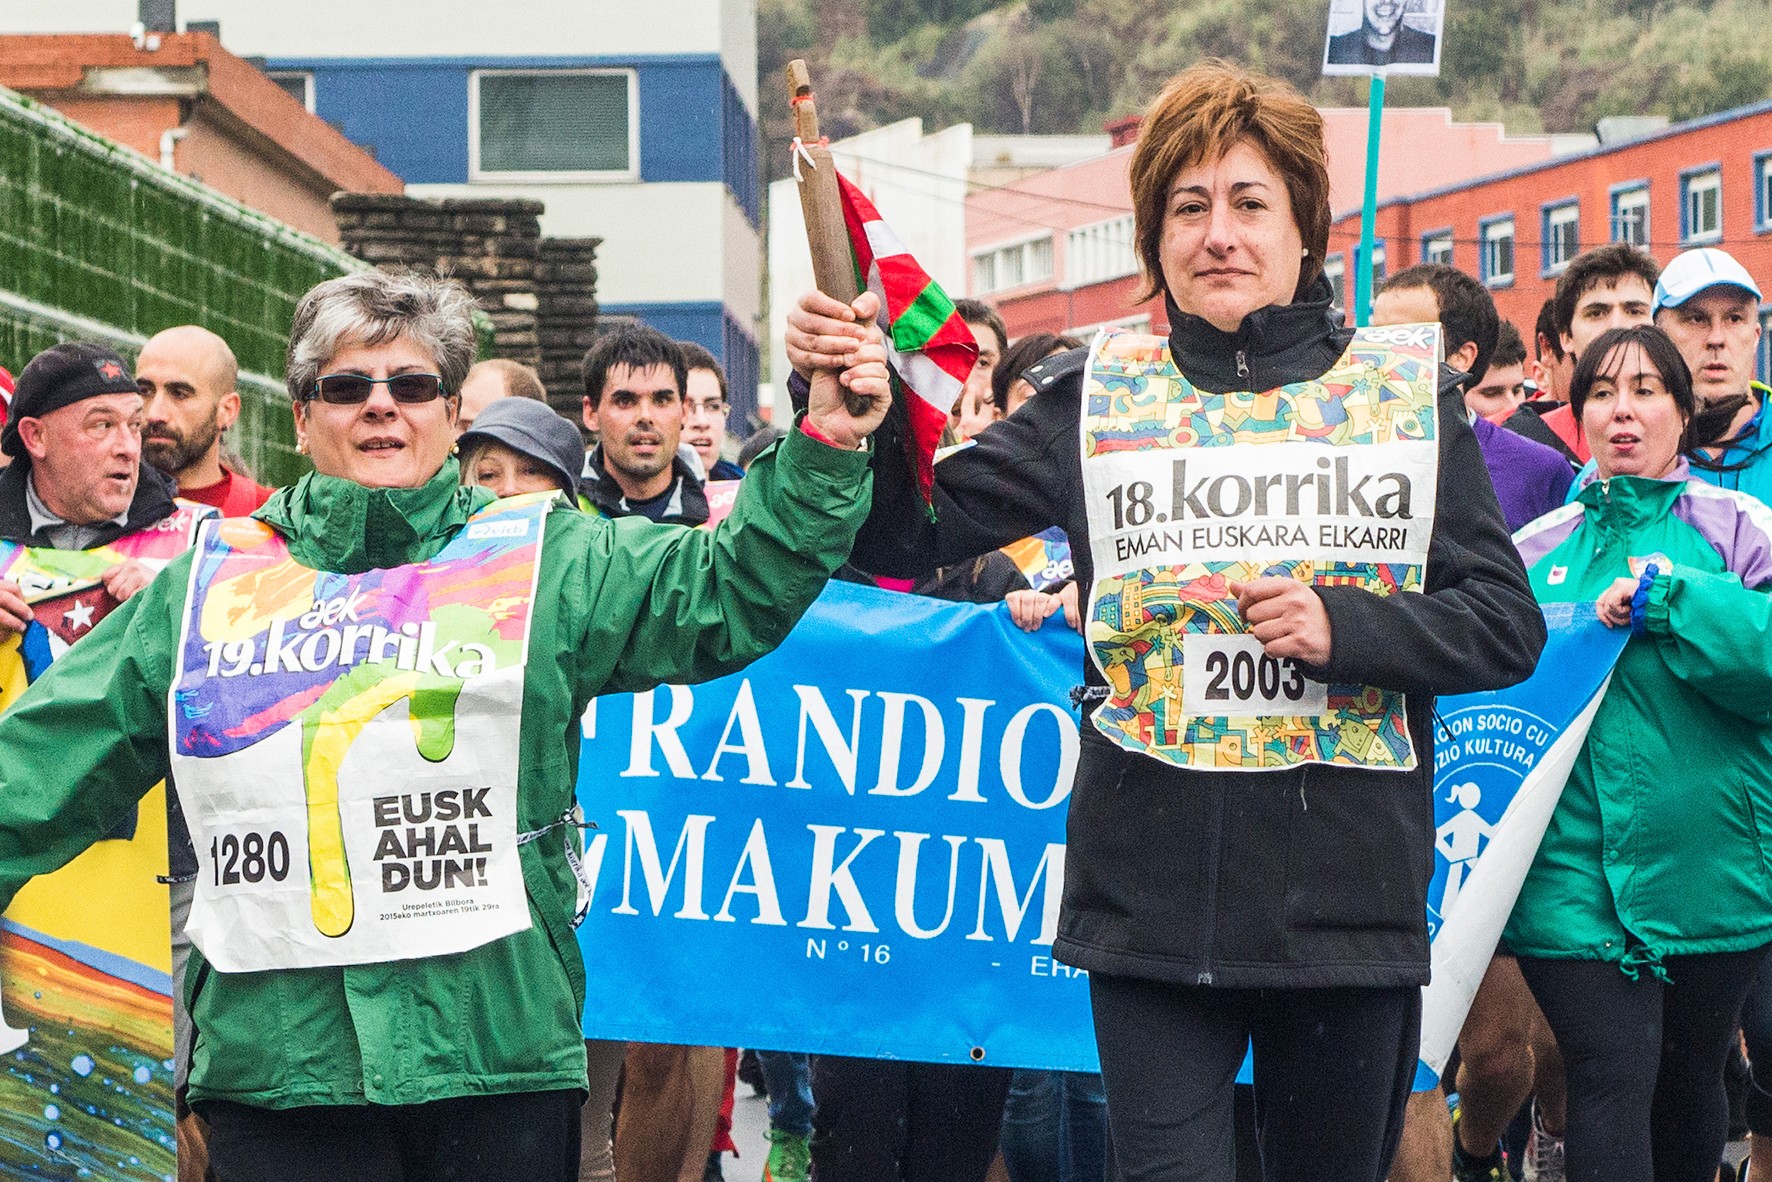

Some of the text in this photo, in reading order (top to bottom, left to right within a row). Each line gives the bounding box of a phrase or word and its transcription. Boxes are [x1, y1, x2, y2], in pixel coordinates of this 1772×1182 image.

[1363, 327, 1433, 350] aek
[709, 491, 735, 508] ae
[1106, 456, 1414, 530] 18.korrika
[143, 511, 189, 532] ek
[1115, 525, 1407, 562] EMAN EUSKARA ELKARRI
[1041, 559, 1074, 580] ae
[300, 585, 368, 630] aek
[203, 617, 497, 678] 19.korrika
[1205, 650, 1305, 701] 2003
[583, 678, 1081, 811] RANDIO
[1434, 716, 1473, 746] CION
[1477, 713, 1523, 735] SOCIO
[1434, 744, 1461, 775] ZIO
[373, 787, 493, 828] EUSK
[210, 830, 290, 887] 1280
[373, 823, 493, 861] AHAL
[382, 857, 489, 893] DUN!
[583, 809, 1066, 945] MAKUM
[380, 911, 412, 921] 2015eko
[413, 907, 459, 919] martxoaren
[402, 899, 474, 911] Urepeletik Bilbora
